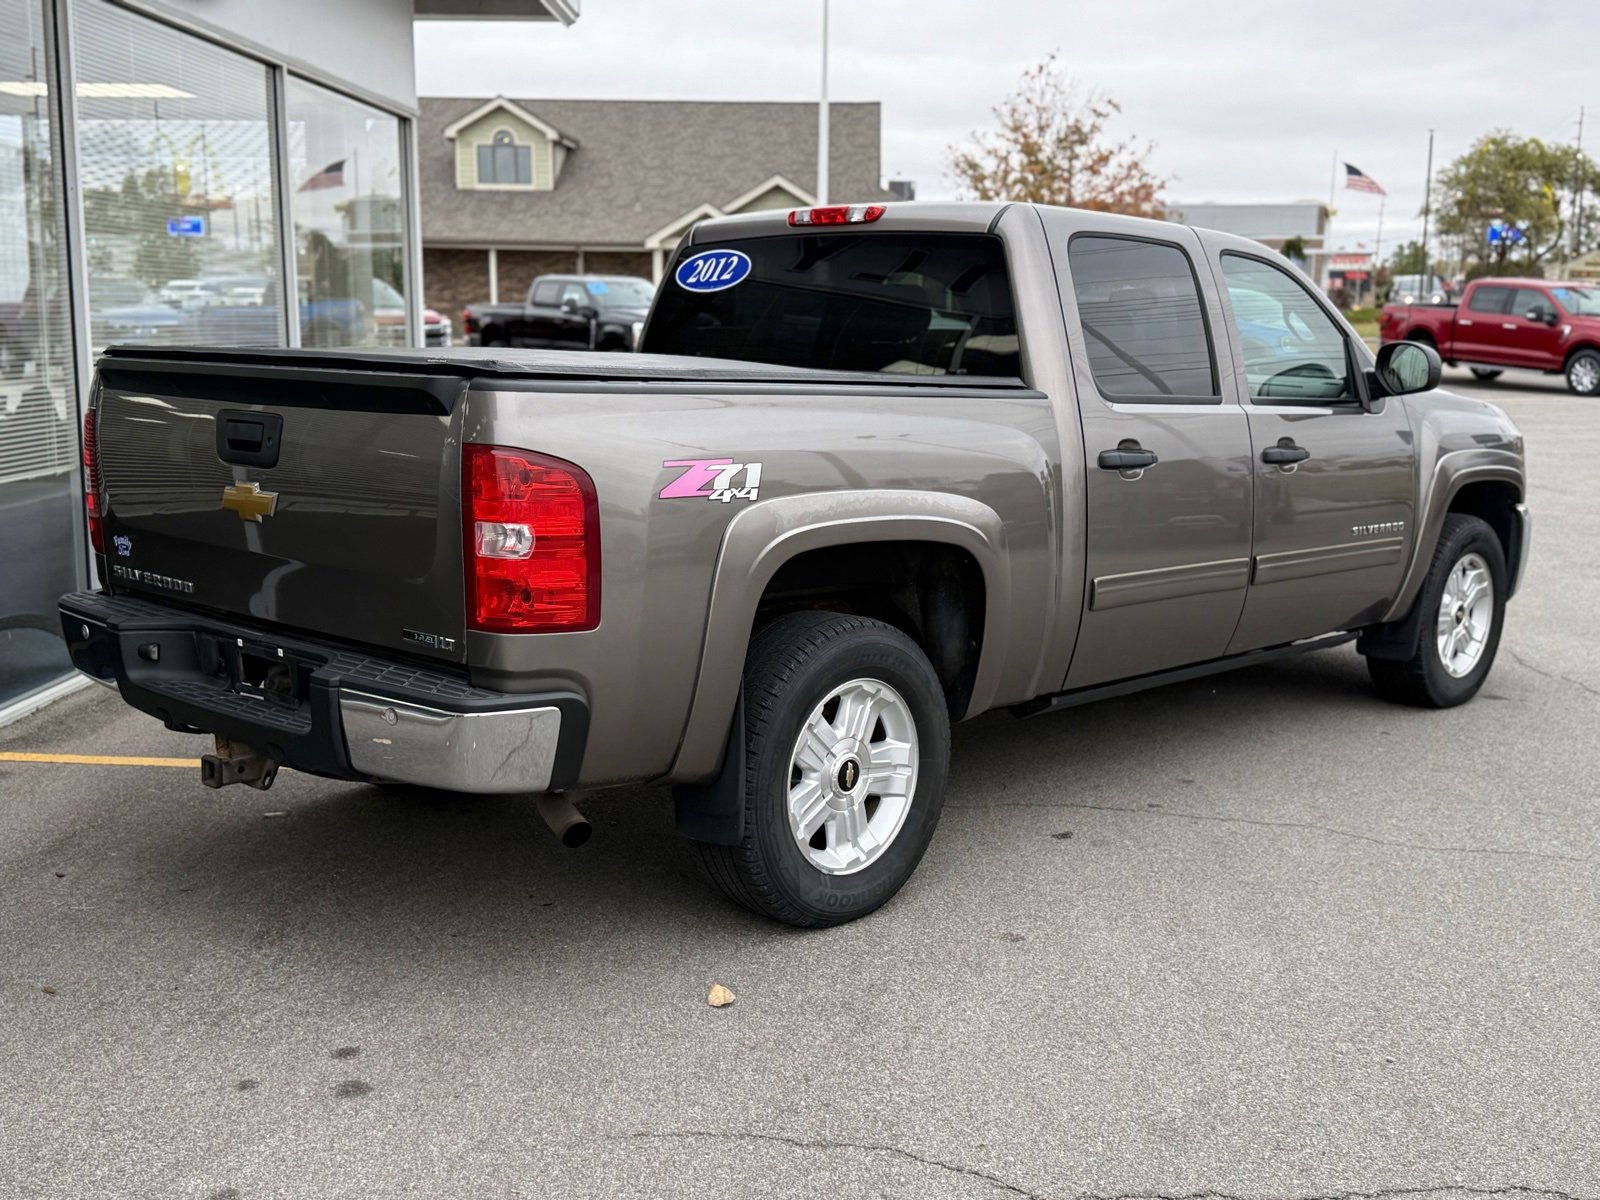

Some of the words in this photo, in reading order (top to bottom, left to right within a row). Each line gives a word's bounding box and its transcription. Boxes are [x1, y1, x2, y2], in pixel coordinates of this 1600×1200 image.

[686, 255, 738, 283] 2012
[658, 457, 762, 499] Z71
[1352, 521, 1404, 535] SILVERADO
[113, 565, 194, 593] SILVERADO
